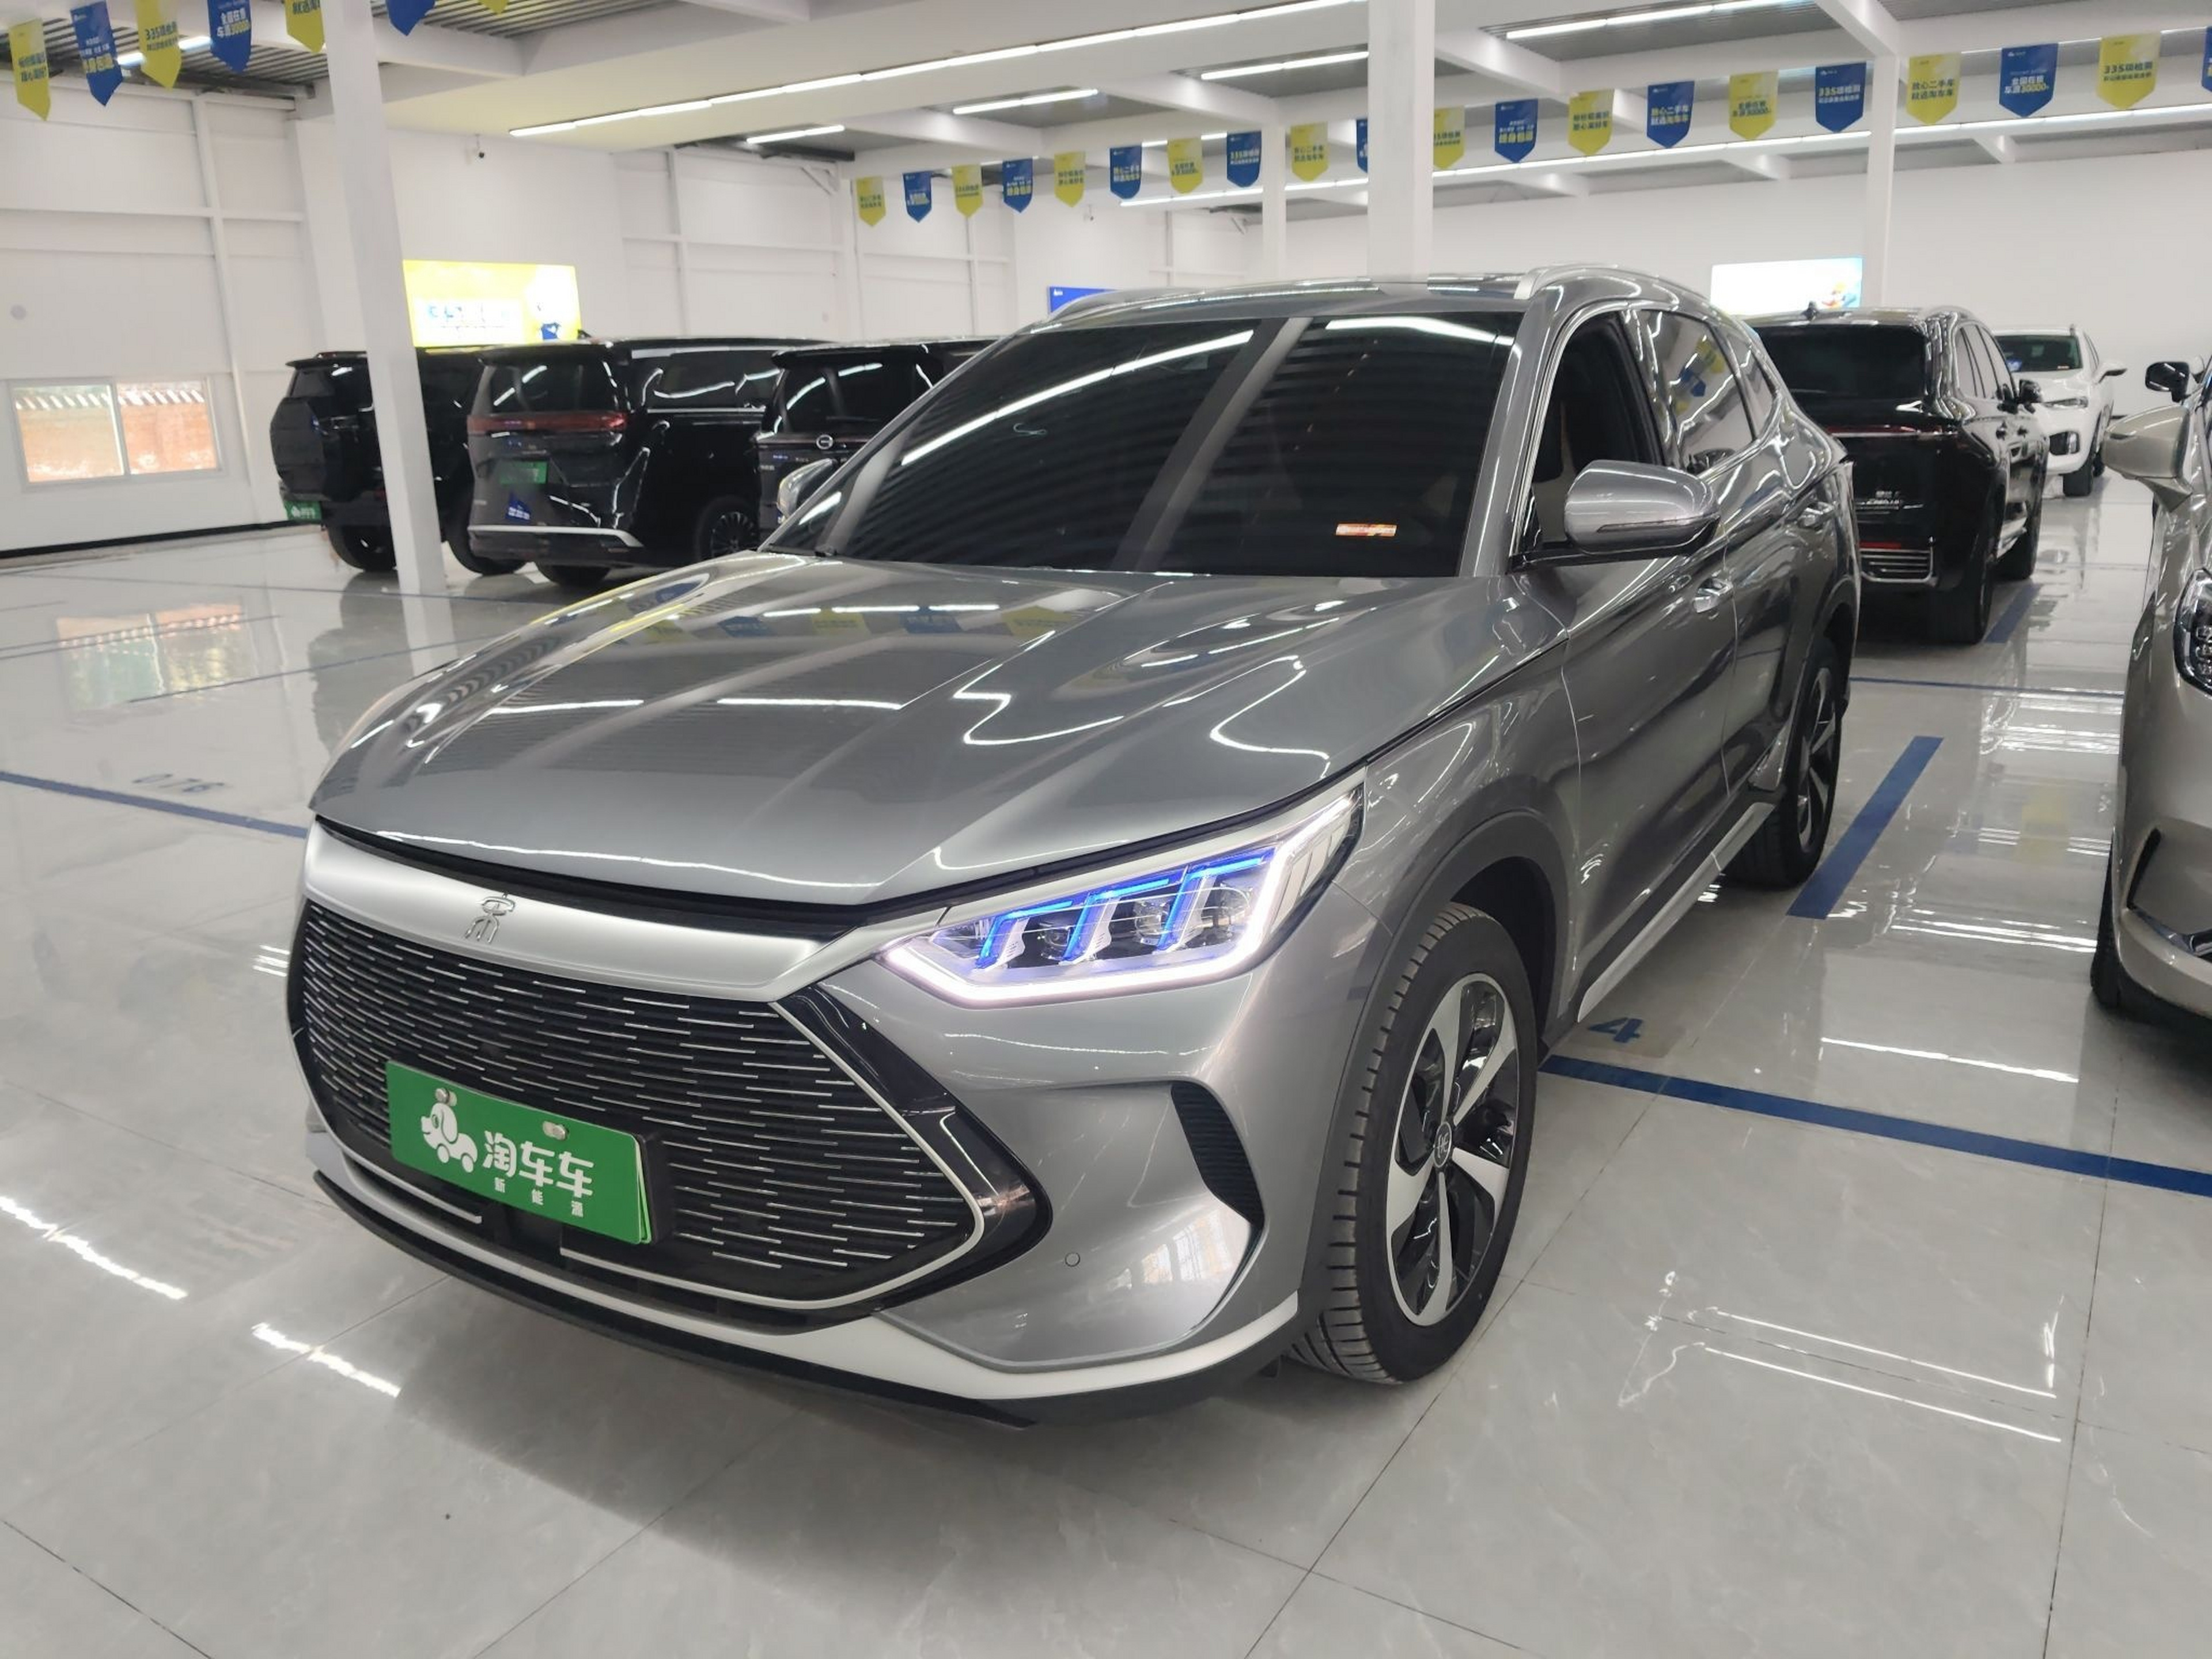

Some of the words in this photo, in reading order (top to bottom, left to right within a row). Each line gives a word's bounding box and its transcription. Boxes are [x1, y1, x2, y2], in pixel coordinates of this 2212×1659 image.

[1588, 1017, 1643, 1043] 4
[482, 1130, 594, 1199] 淘车车
